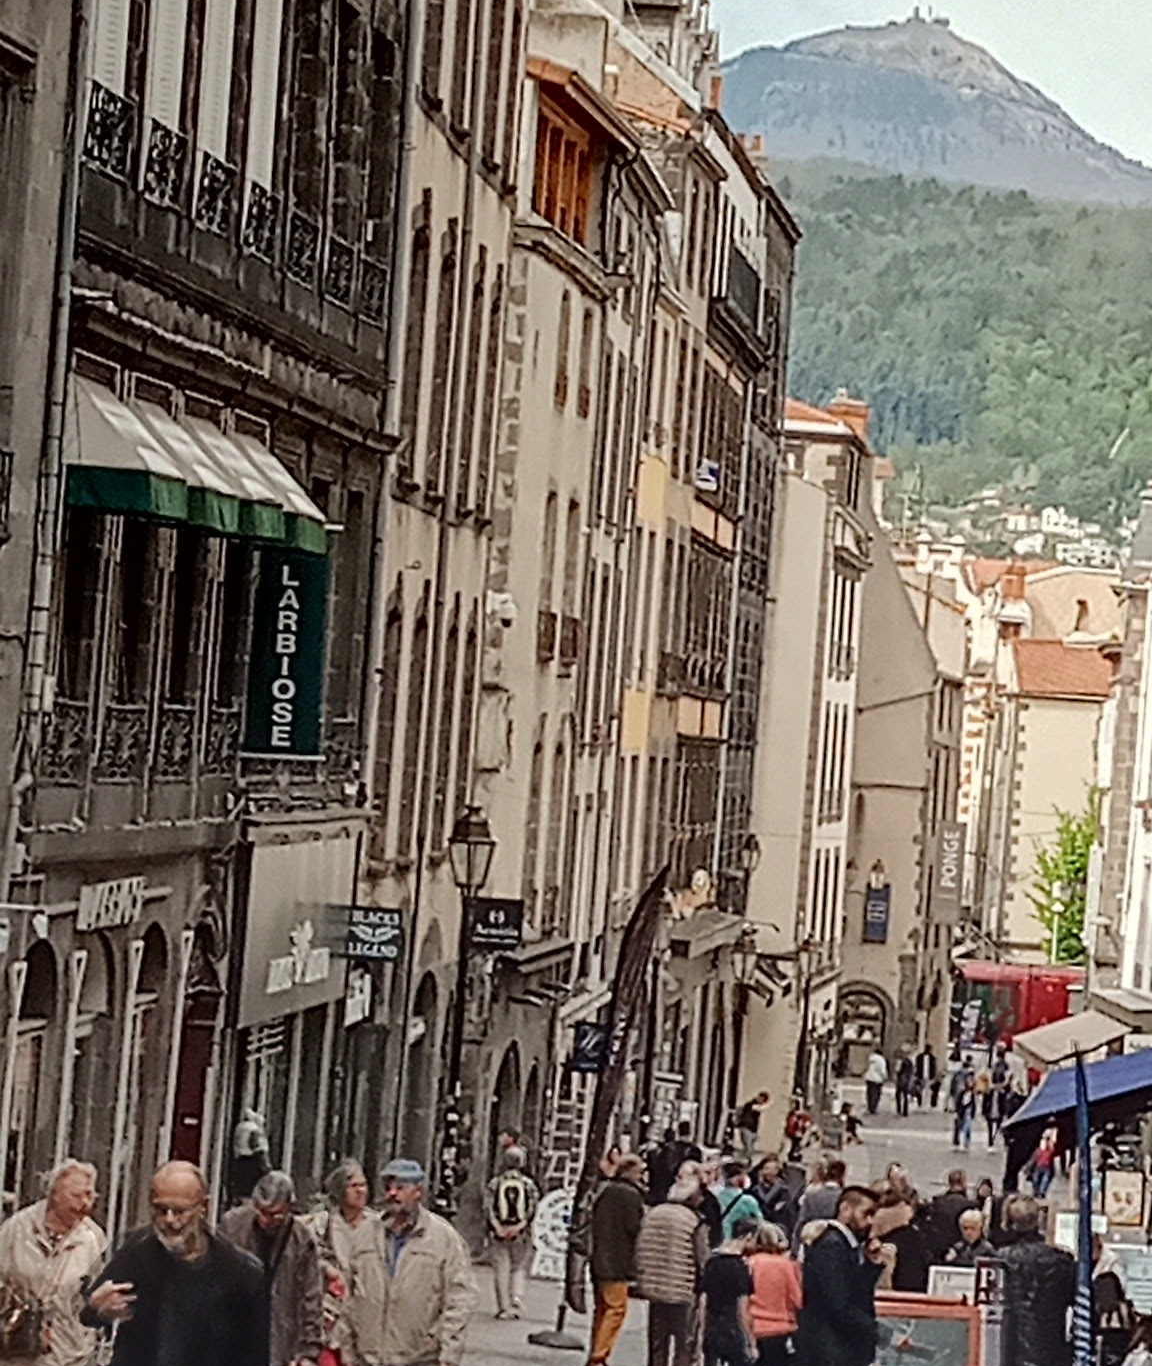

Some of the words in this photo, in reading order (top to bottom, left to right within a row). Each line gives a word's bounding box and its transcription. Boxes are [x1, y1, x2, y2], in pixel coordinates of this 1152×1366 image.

[271, 565, 300, 747] LARBIOSE
[940, 830, 961, 889] PONGE
[348, 941, 398, 958] LEGEND
